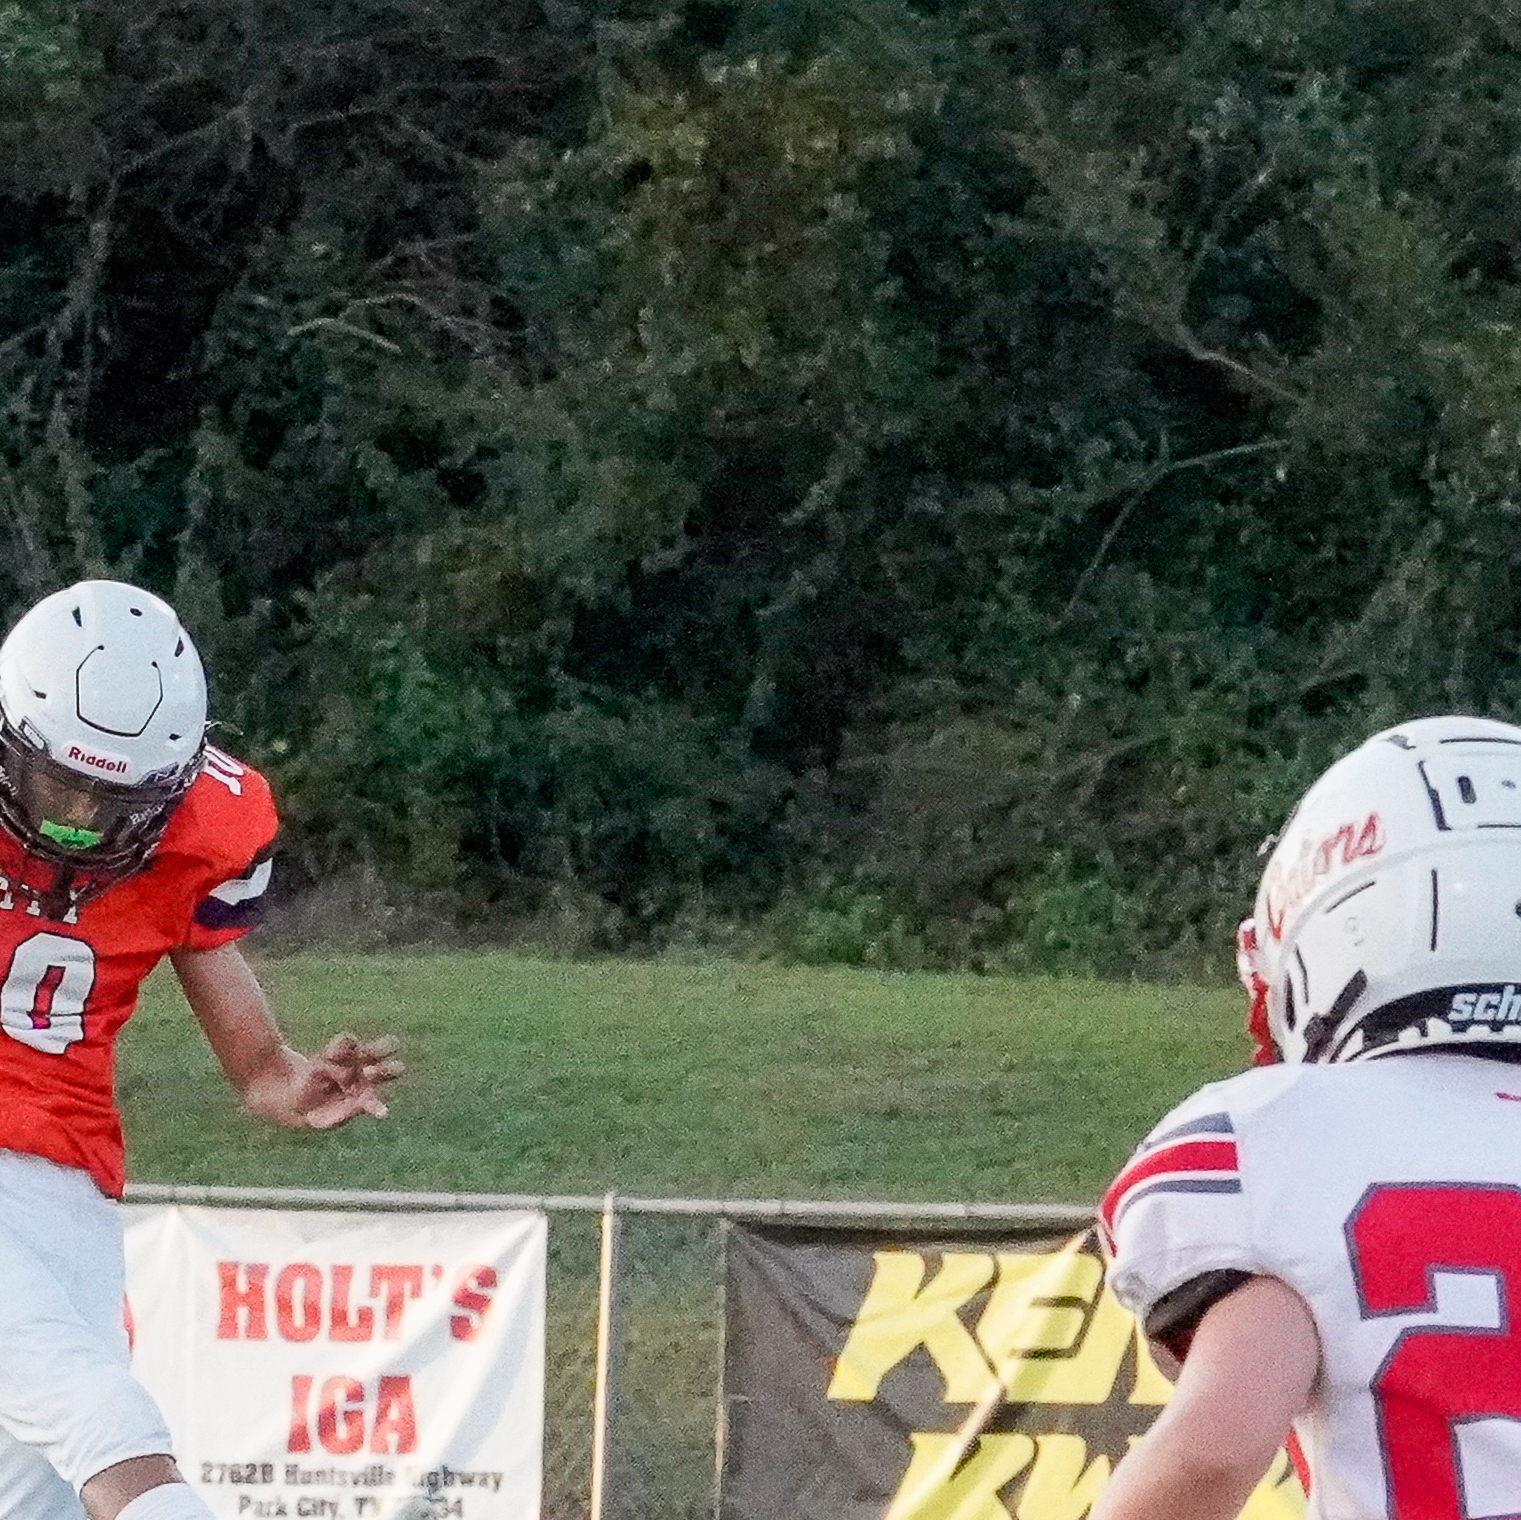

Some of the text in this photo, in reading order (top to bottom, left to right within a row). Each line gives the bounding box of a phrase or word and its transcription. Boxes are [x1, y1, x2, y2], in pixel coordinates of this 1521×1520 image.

[67, 744, 128, 774] Riddell
[216, 1261, 498, 1343] HOLT'S
[287, 1374, 418, 1454] IGA
